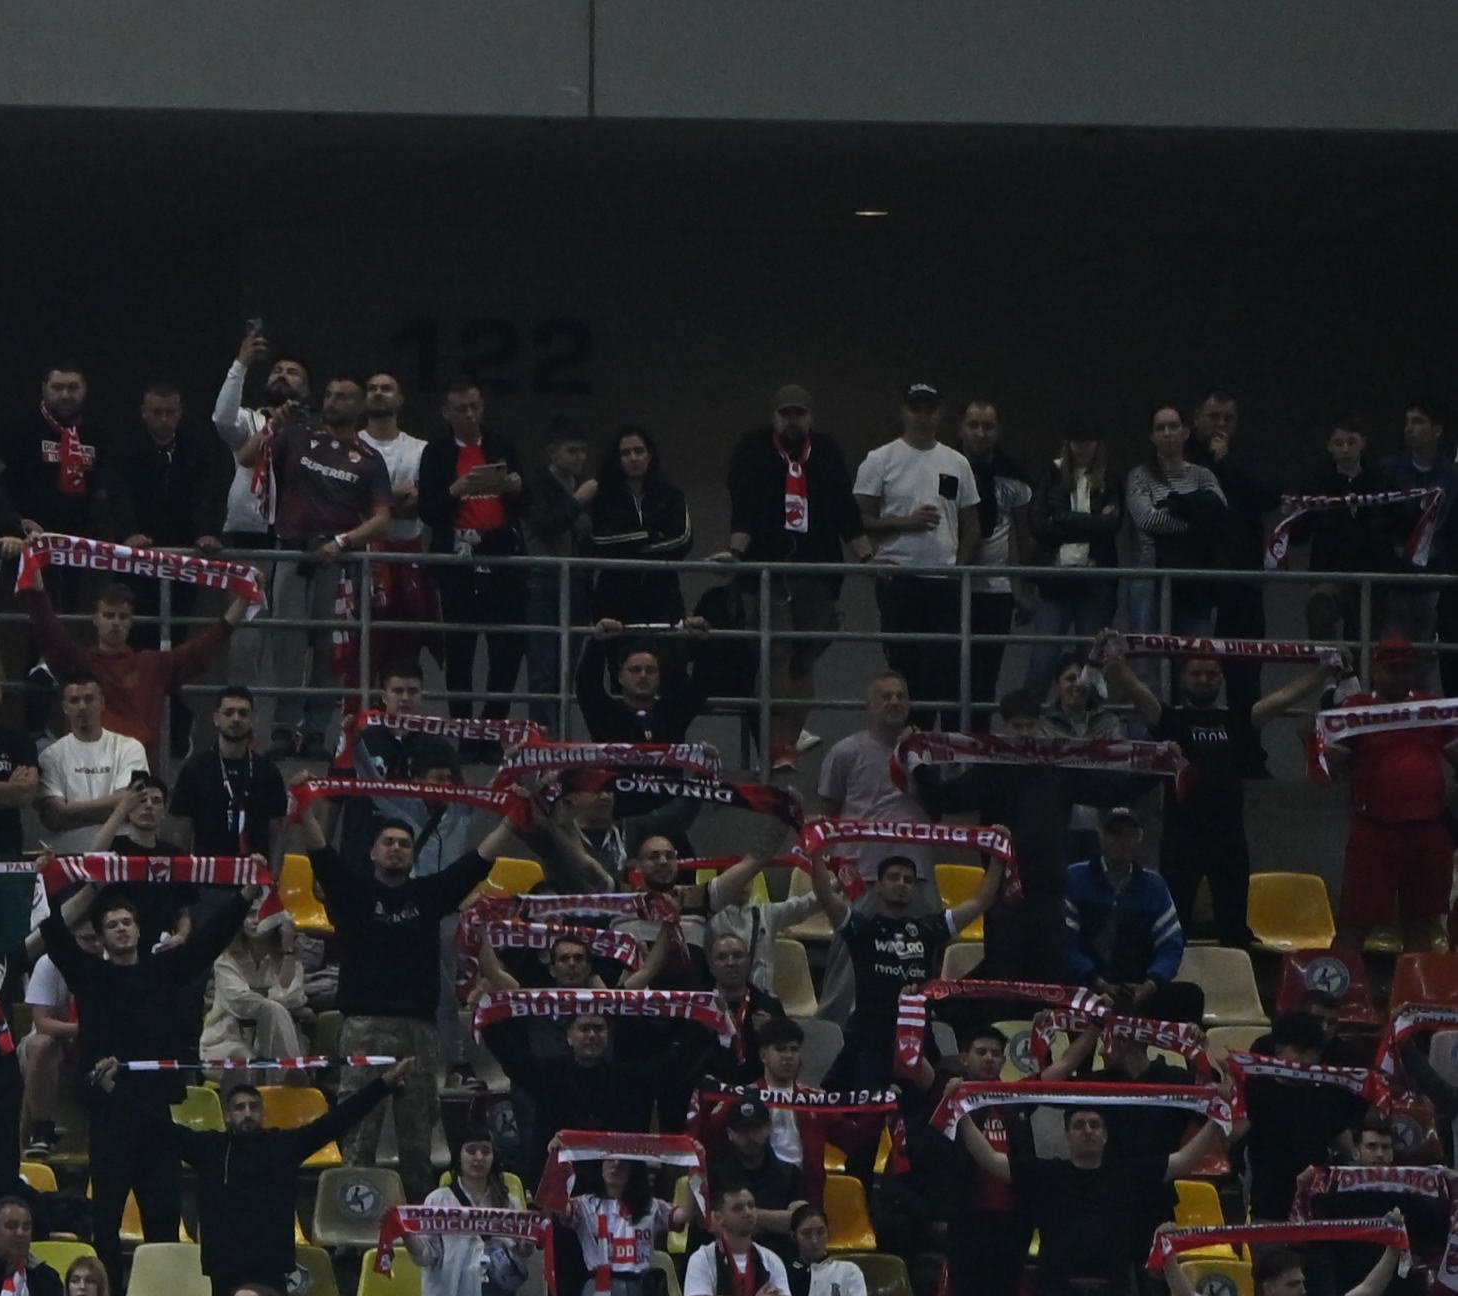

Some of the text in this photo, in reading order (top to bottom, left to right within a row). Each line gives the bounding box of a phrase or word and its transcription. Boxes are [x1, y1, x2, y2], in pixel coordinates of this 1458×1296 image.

[299, 456, 360, 484] SUPERBET
[50, 550, 231, 588] BUCURESTI
[366, 711, 532, 744] BUCURESTI
[614, 778, 734, 803] DINAMO
[510, 999, 694, 1019] BUCURESTI
[760, 1084, 896, 1106] DINAMO 1948
